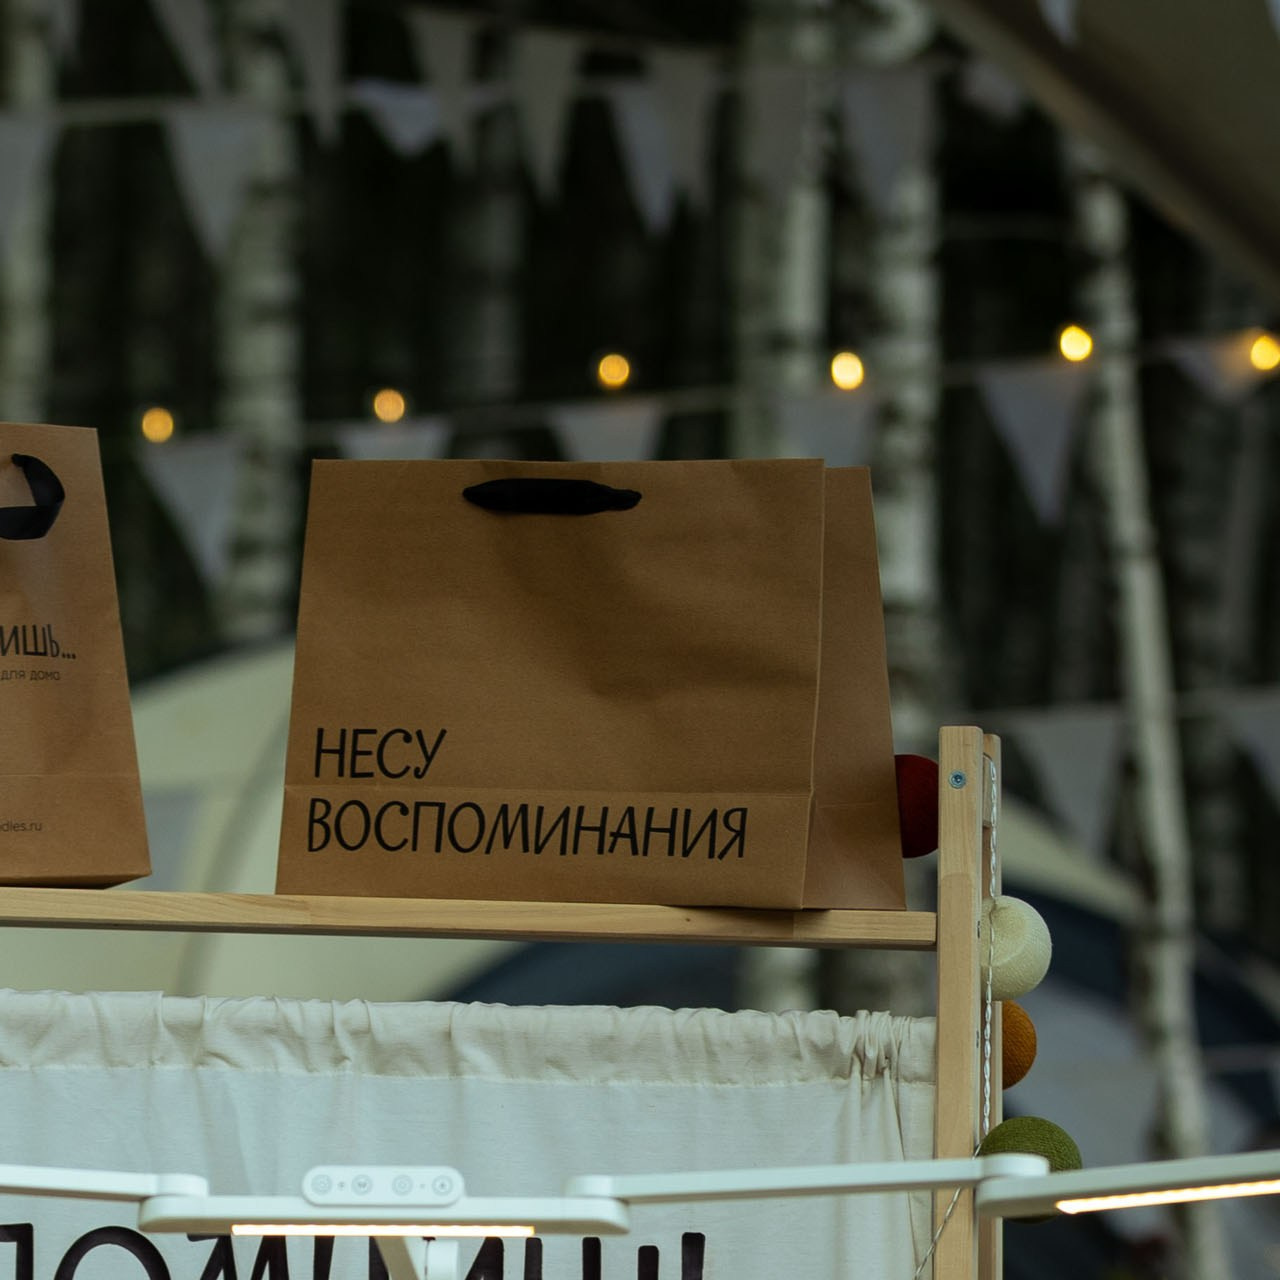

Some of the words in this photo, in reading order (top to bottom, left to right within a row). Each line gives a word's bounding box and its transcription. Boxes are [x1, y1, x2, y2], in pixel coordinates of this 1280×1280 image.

[1, 669, 25, 681] для
[29, 669, 61, 681] дома
[313, 727, 447, 779] НЕСУ
[307, 797, 748, 860] ВОСПОМИНАНИЯ
